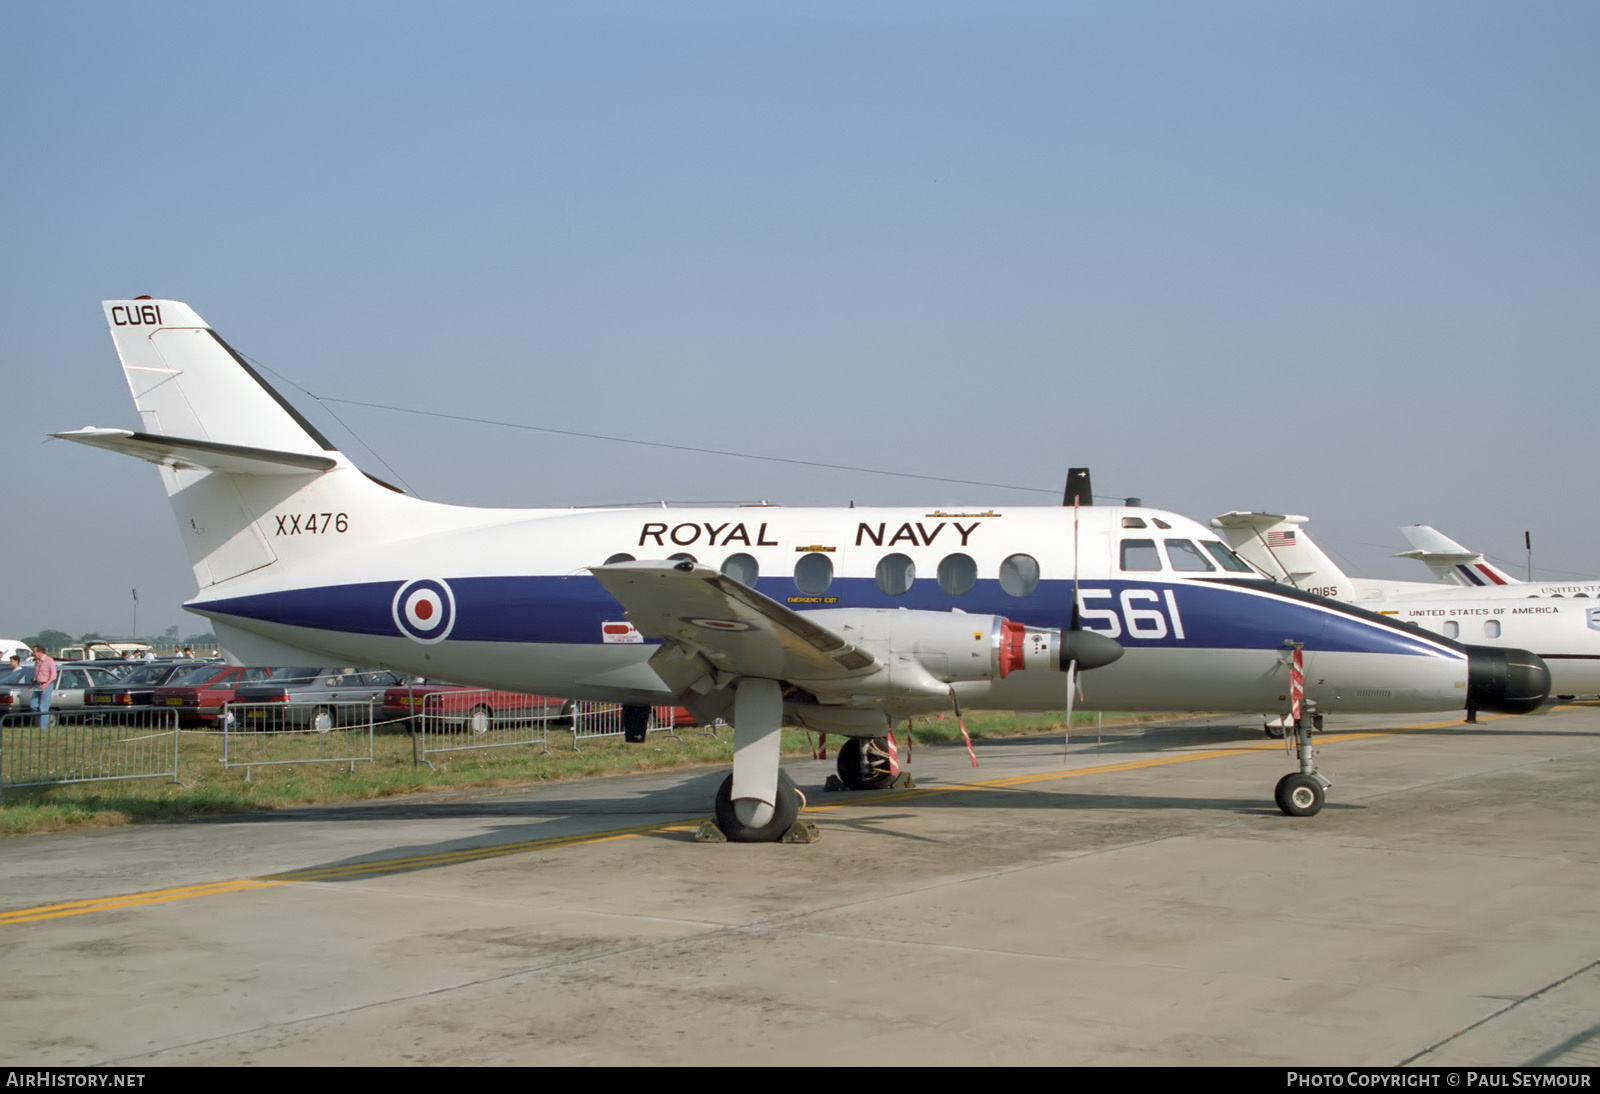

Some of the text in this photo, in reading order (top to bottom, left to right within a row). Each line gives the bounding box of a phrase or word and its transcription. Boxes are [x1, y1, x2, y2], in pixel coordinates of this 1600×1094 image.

[276, 512, 348, 536] XX476
[638, 522, 981, 547] ROYAL NAVY
[1541, 586, 1581, 594] UNITED
[1079, 588, 1186, 640] 561
[1409, 606, 1559, 617] UNITED STATES OF AMERICA
